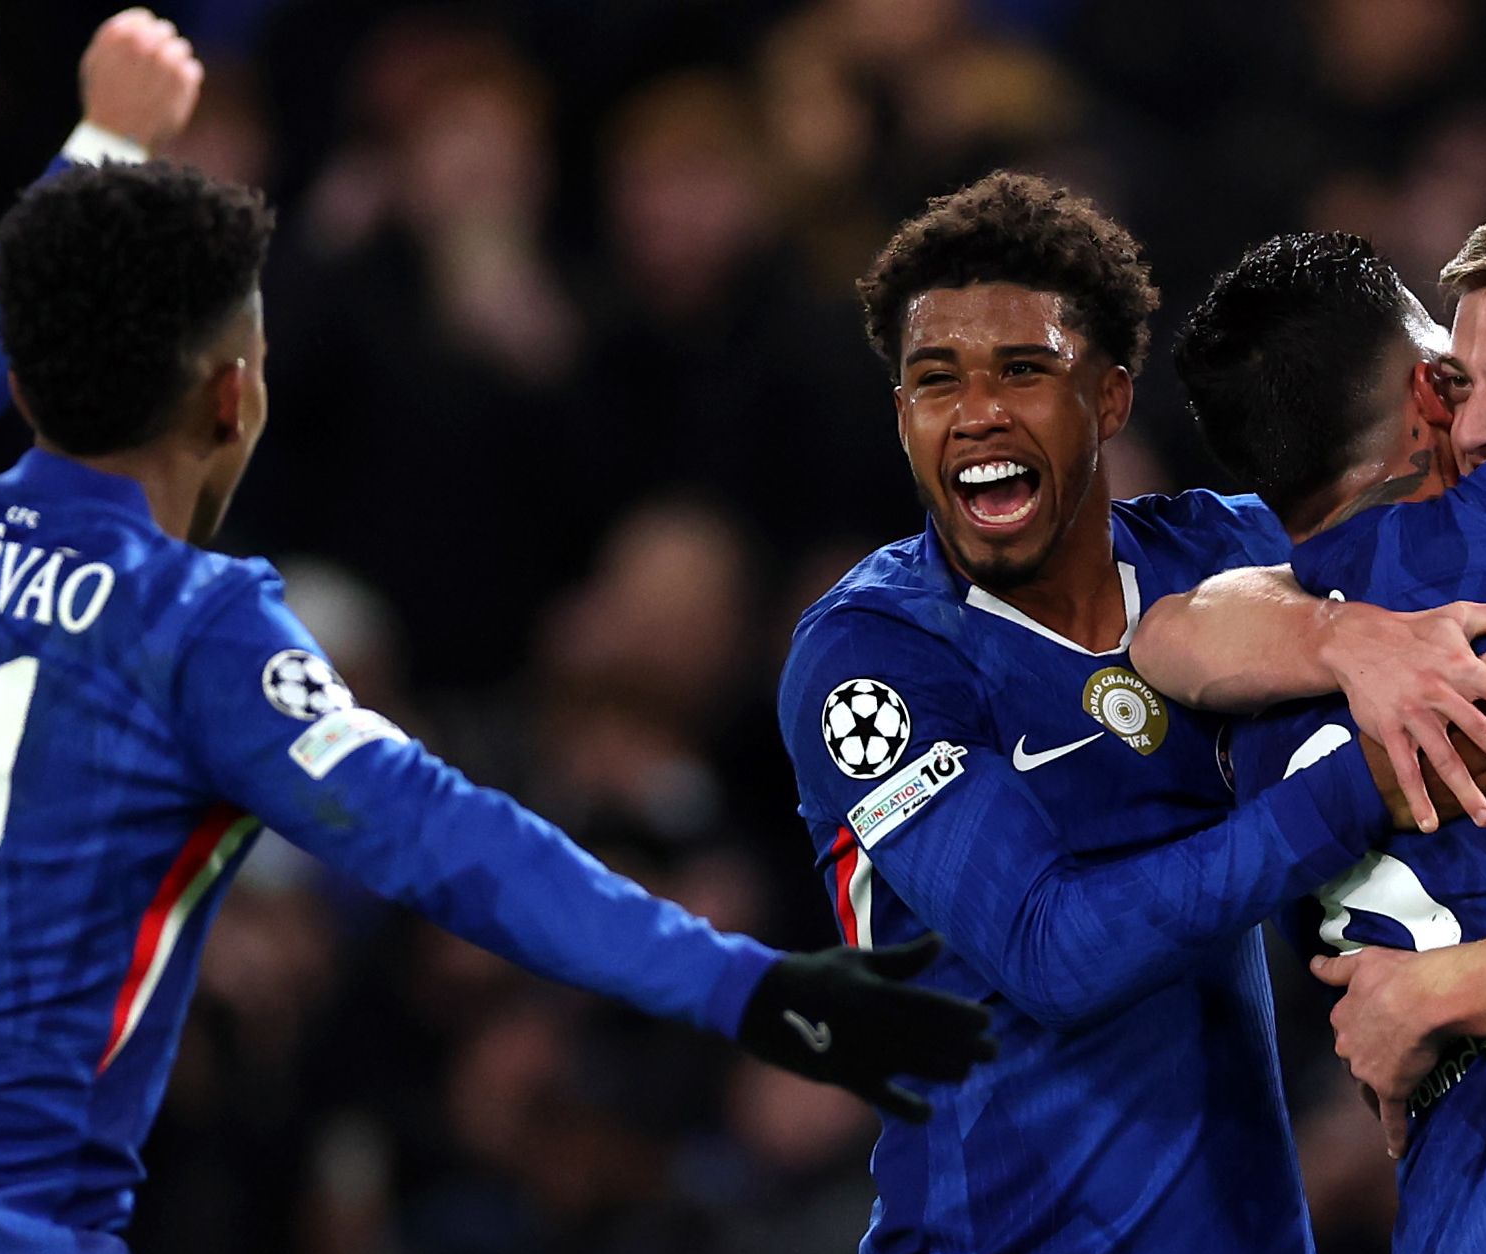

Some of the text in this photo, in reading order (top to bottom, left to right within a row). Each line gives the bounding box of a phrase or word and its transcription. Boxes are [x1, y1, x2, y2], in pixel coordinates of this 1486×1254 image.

[1101, 674, 1160, 716] CHAMPIONS
[920, 755, 956, 786] 10
[856, 778, 924, 836] FOUNDATION
